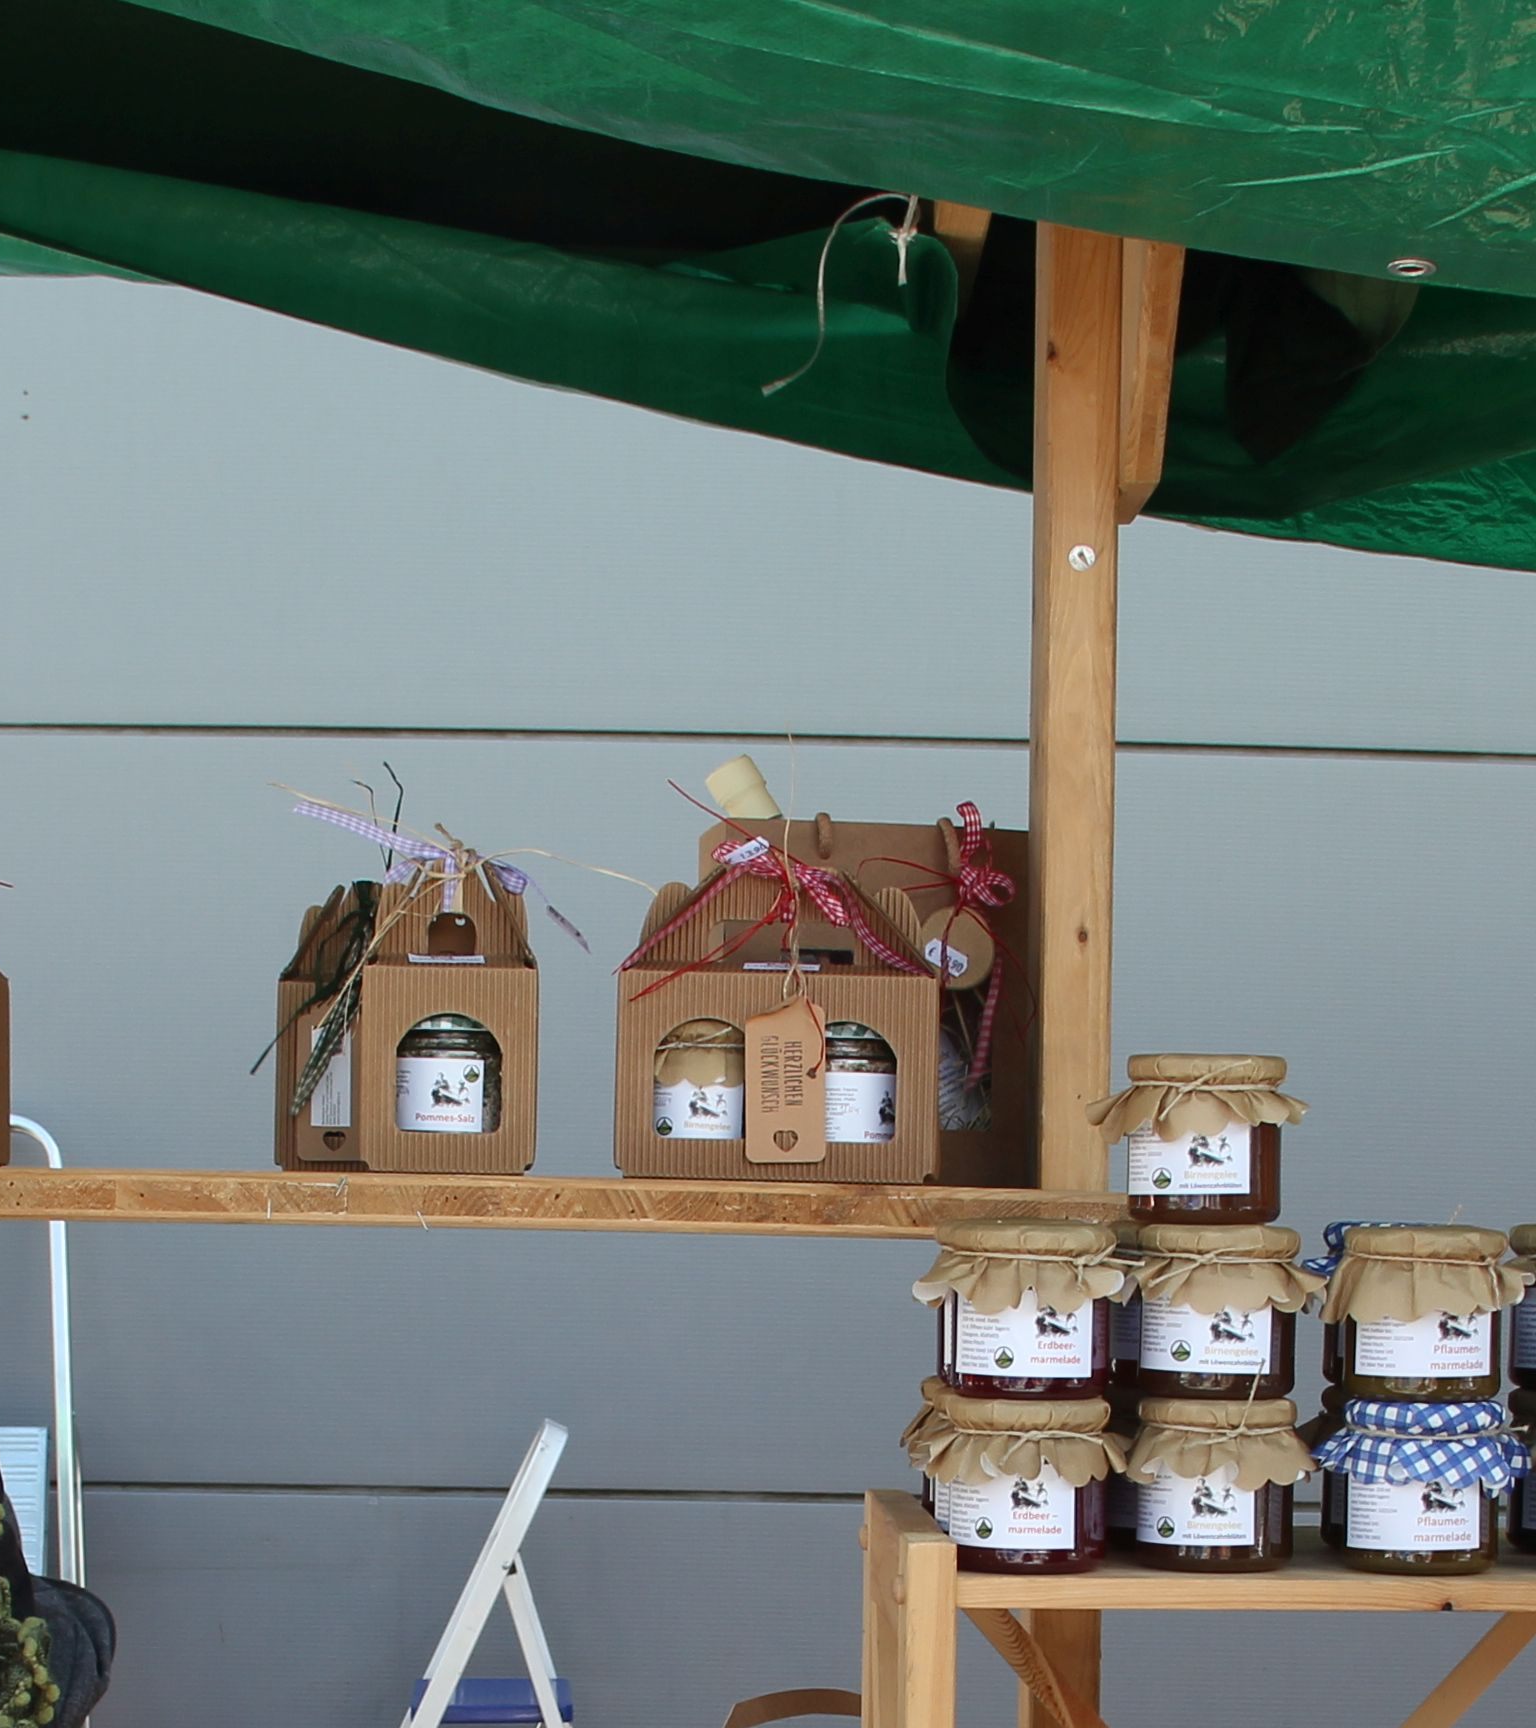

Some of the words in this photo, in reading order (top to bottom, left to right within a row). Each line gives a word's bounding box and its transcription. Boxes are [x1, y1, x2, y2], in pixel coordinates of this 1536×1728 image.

[761, 1035, 781, 1113] GLÜCKWUNSCH
[783, 1040, 803, 1107] HERZLICHEN
[415, 1112, 475, 1124] Pommes-Salz
[683, 1120, 731, 1132] Birnengelee
[1184, 1171, 1238, 1183] Birnengelee
[1037, 1340, 1076, 1350] Erdbeer-
[1433, 1344, 1482, 1355] Pflaumen-
[1204, 1346, 1259, 1358] Birnengelee
[1030, 1354, 1082, 1365] marmelade
[1430, 1360, 1484, 1371] marmelade
[1012, 1511, 1050, 1520] Erdbeer
[1186, 1520, 1244, 1532] Birnengelee
[1416, 1517, 1469, 1527] Pflaumen-
[1008, 1525, 1062, 1534] marmelade
[1413, 1532, 1472, 1542] marmelade
